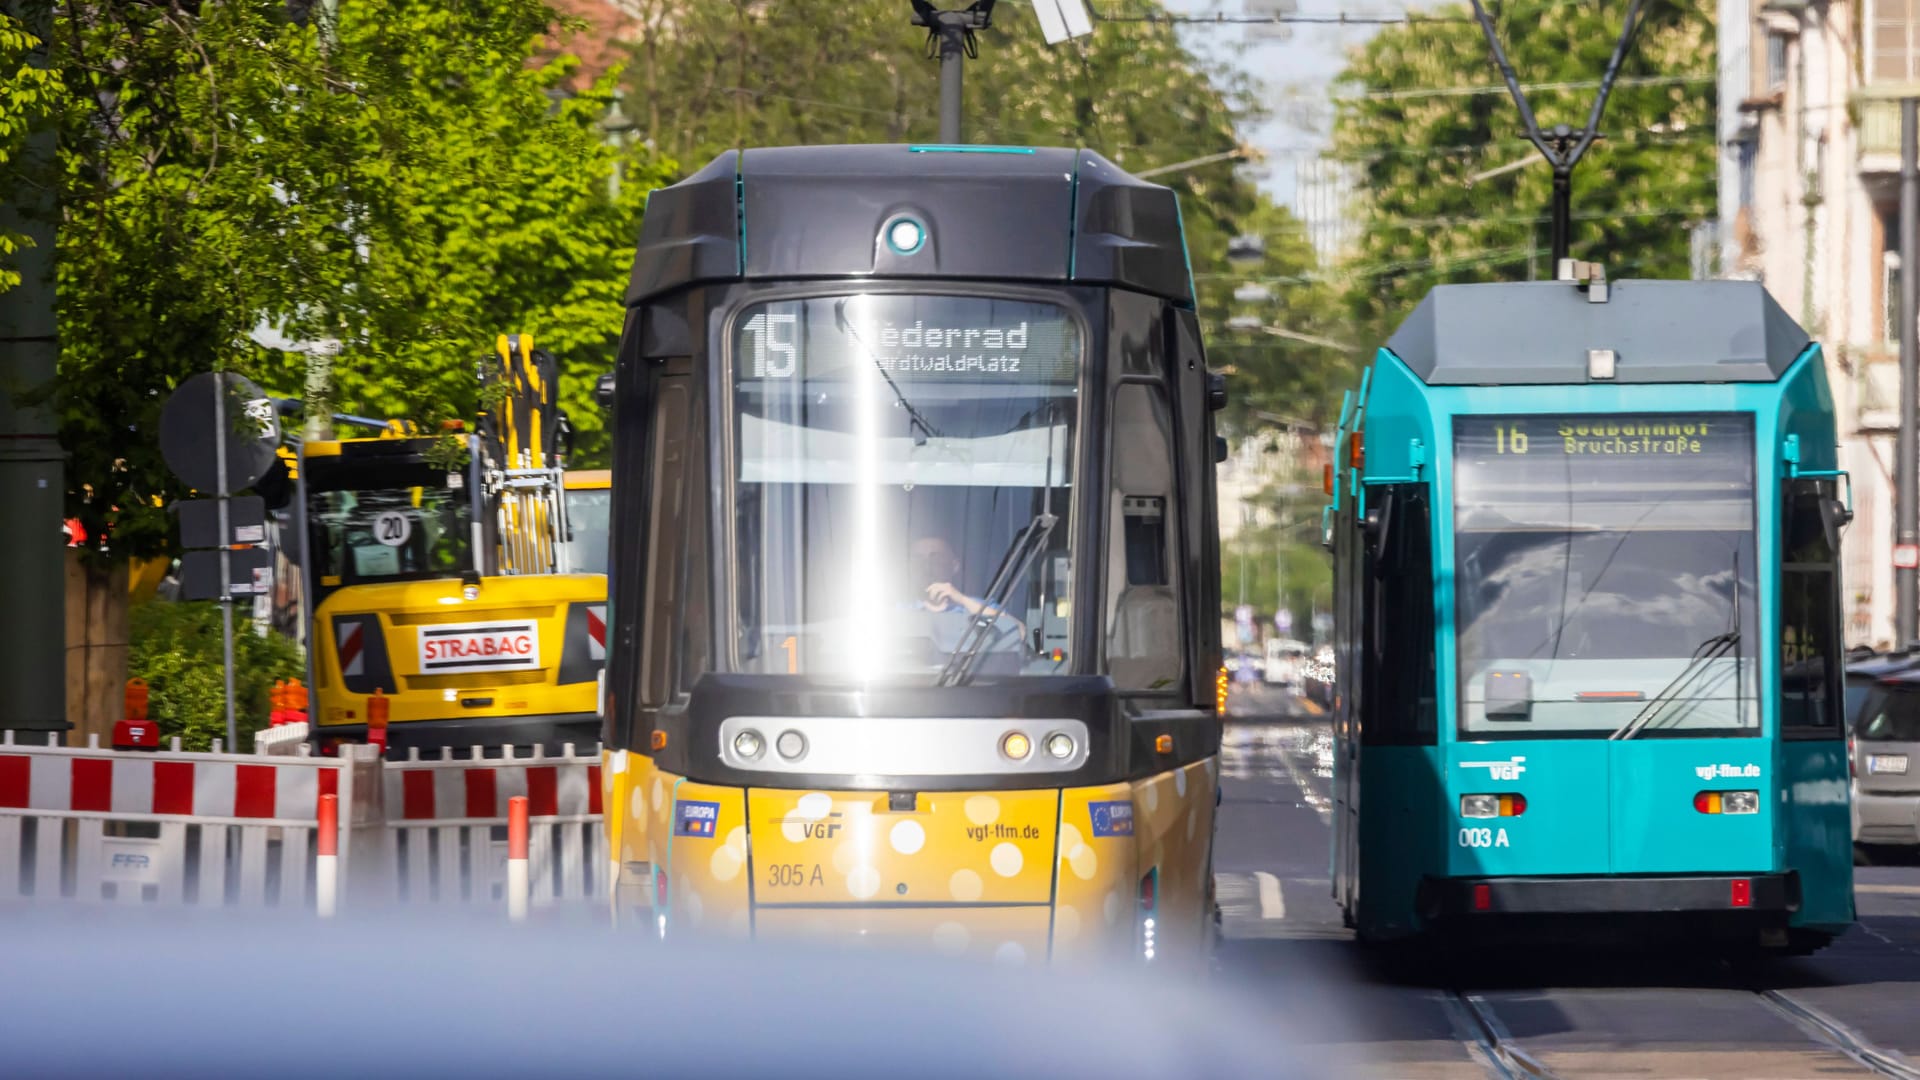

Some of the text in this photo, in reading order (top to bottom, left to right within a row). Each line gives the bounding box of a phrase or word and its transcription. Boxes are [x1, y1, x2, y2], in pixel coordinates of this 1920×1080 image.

[743, 314, 796, 377] 15
[848, 320, 1027, 349] ederrad
[871, 354, 1020, 372] ardtwaldplatz
[1496, 423, 1528, 454] 16
[1564, 436, 1701, 455] Bruchstraße
[381, 517, 403, 540] 20
[424, 636, 532, 660] STRABAG
[685, 805, 715, 819] EUROPA
[803, 812, 842, 839] VGF
[967, 824, 1040, 841] vgf-ffm.de
[1459, 828, 1510, 848] 003 A
[768, 864, 824, 887] 305 A
